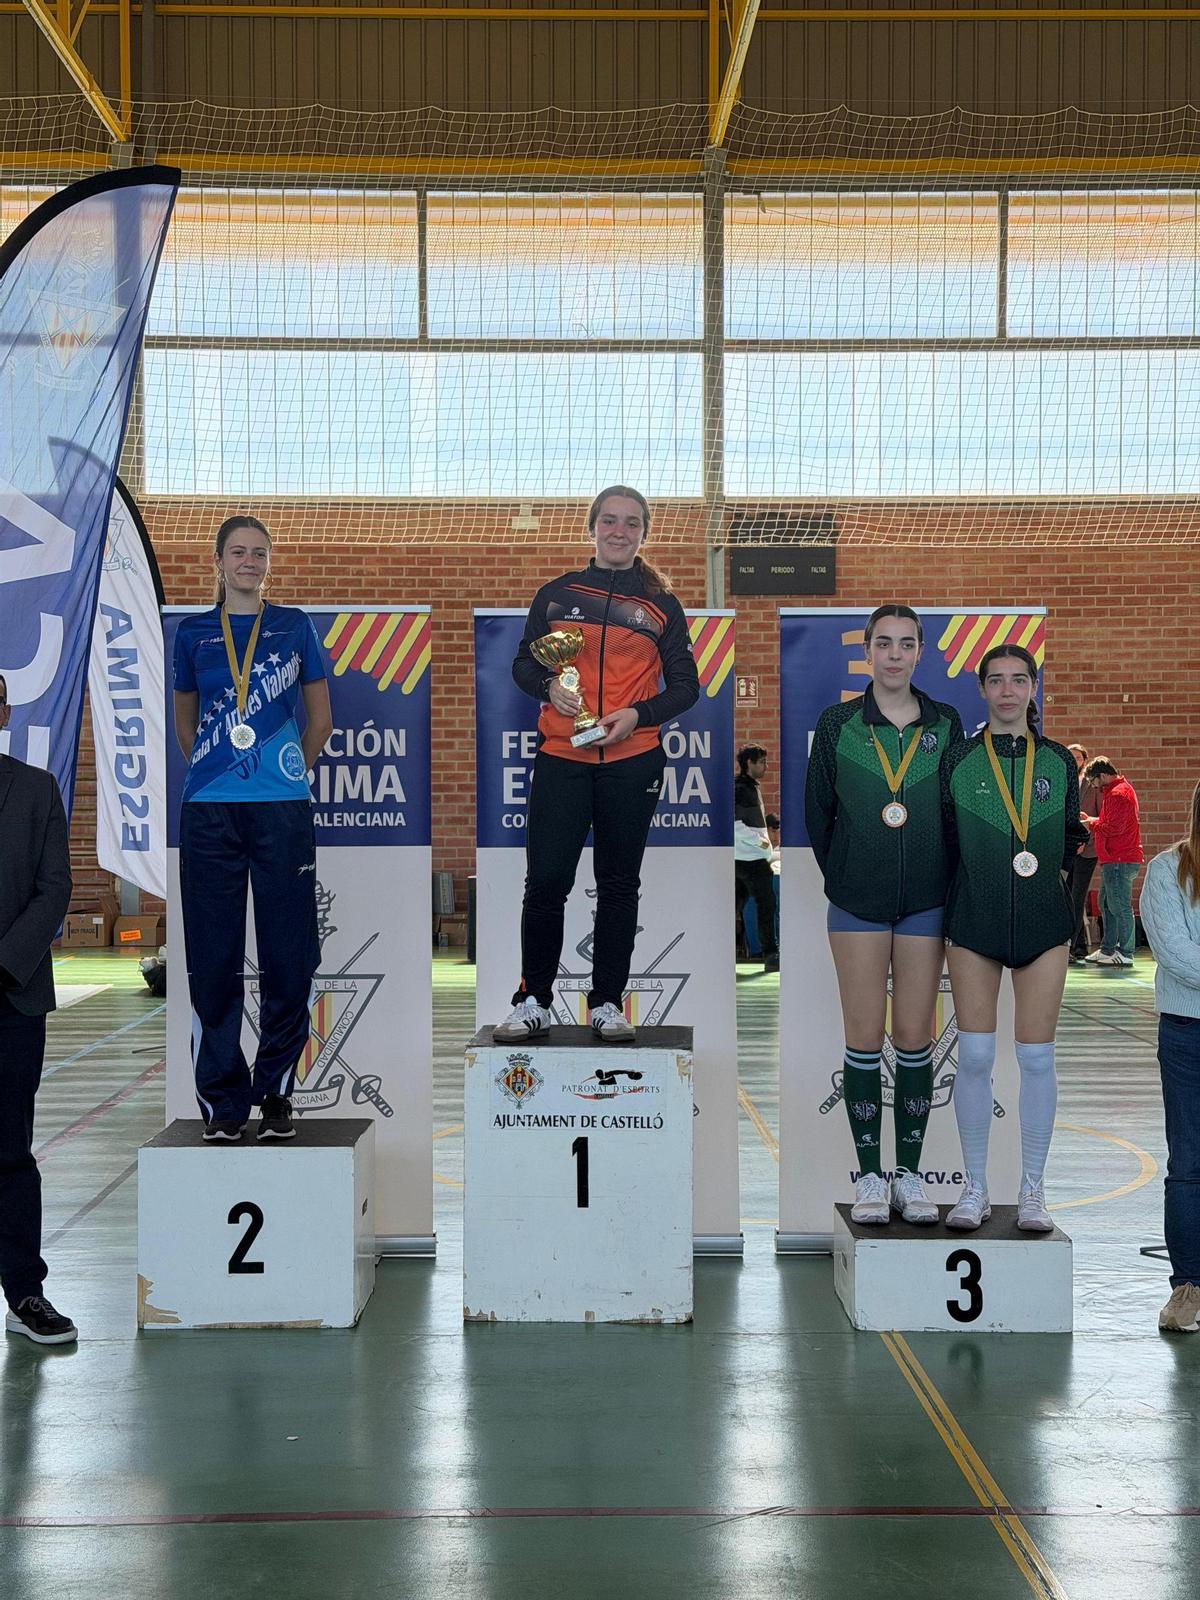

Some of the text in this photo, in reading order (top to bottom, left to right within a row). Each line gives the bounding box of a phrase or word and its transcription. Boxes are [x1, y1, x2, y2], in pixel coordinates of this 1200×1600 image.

[739, 566, 827, 574] FALTAS PERIODO FALTAS
[316, 1010, 355, 1069] COMUNIDAD
[561, 1084, 660, 1094] PATRONAT D'ESPORTS
[493, 1112, 664, 1129] AJUNTAMENT DE CASTELLÓ
[571, 1136, 590, 1209] 1
[227, 1201, 265, 1274] 2
[945, 1248, 984, 1323] 3
